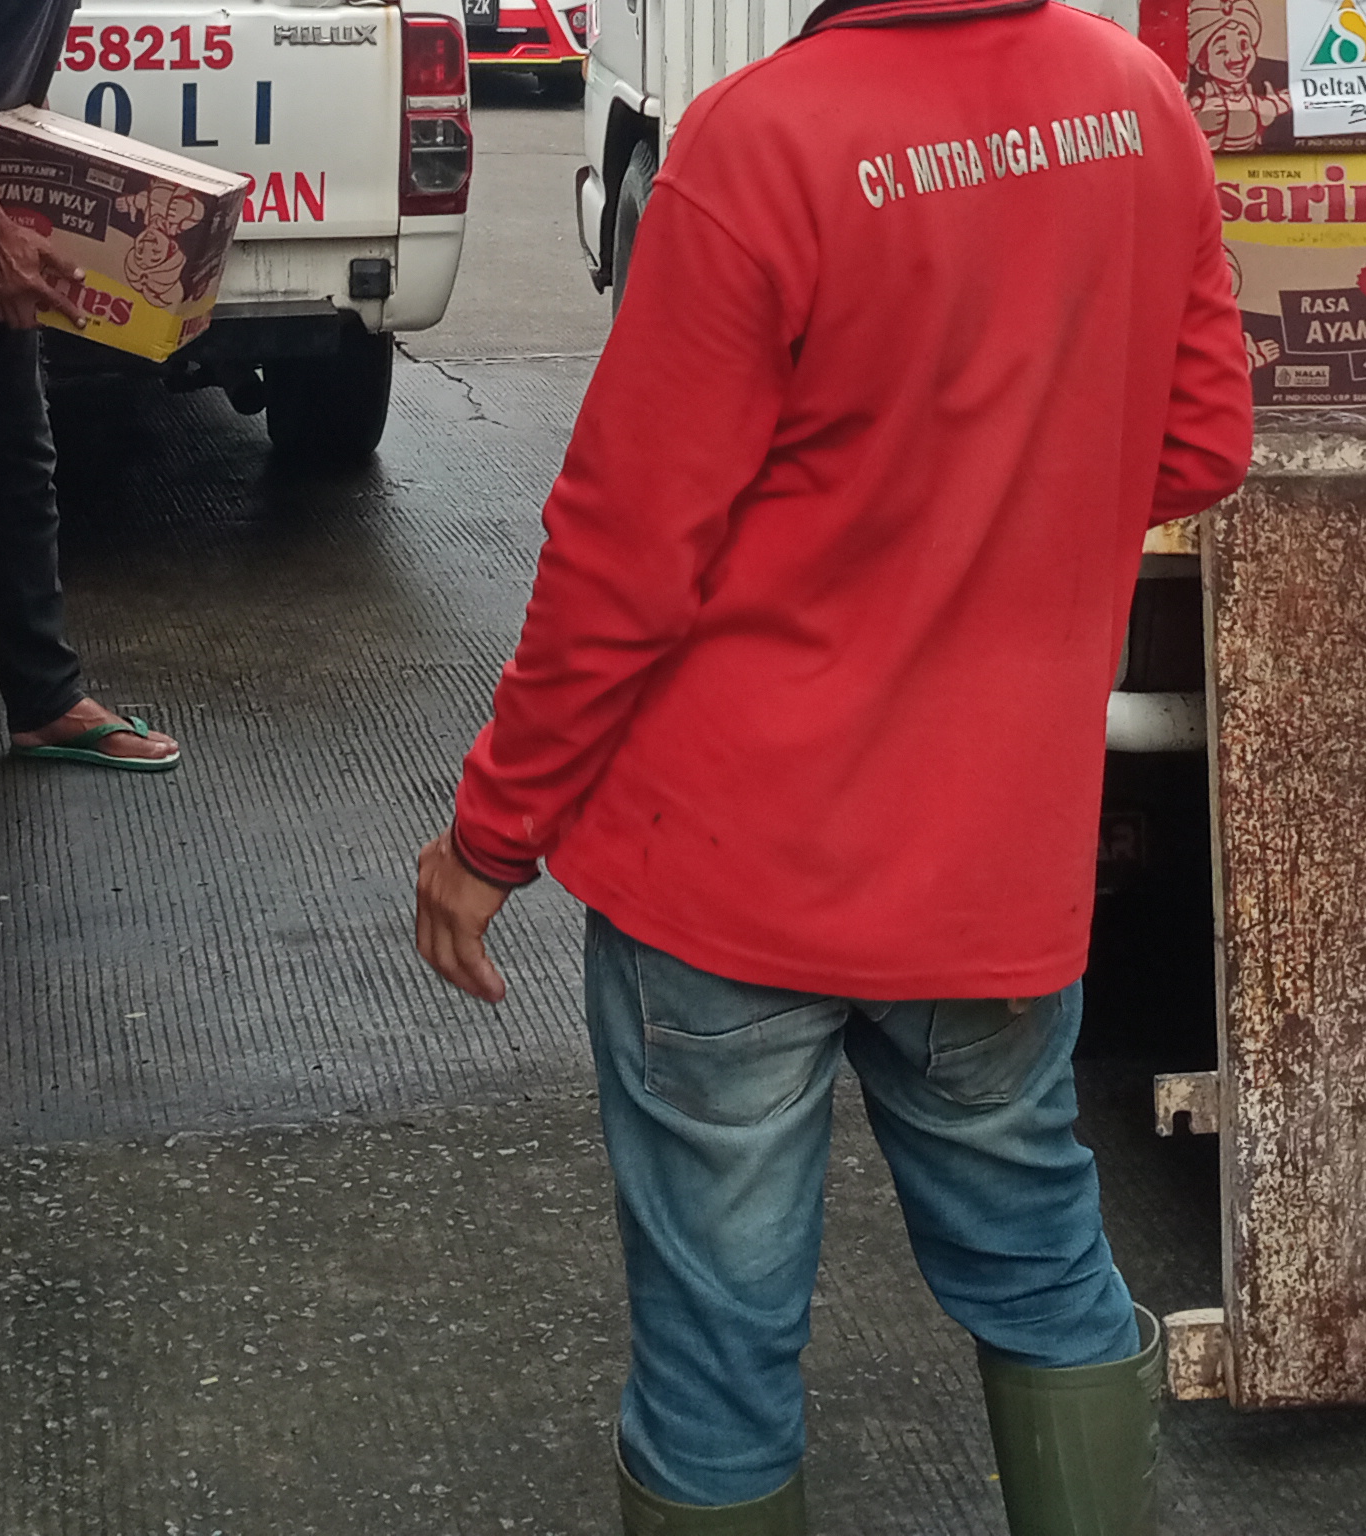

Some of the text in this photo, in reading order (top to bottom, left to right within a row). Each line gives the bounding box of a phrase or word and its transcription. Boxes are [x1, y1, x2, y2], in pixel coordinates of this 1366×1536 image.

[273, 24, 378, 46] HILUX
[905, 138, 987, 195] MITRA
[985, 125, 1050, 180] OGA
[1262, 169, 1302, 180] INSTAN
[48, 189, 98, 215] AYAM
[61, 212, 95, 234] RASA
[1300, 295, 1351, 315] RASA
